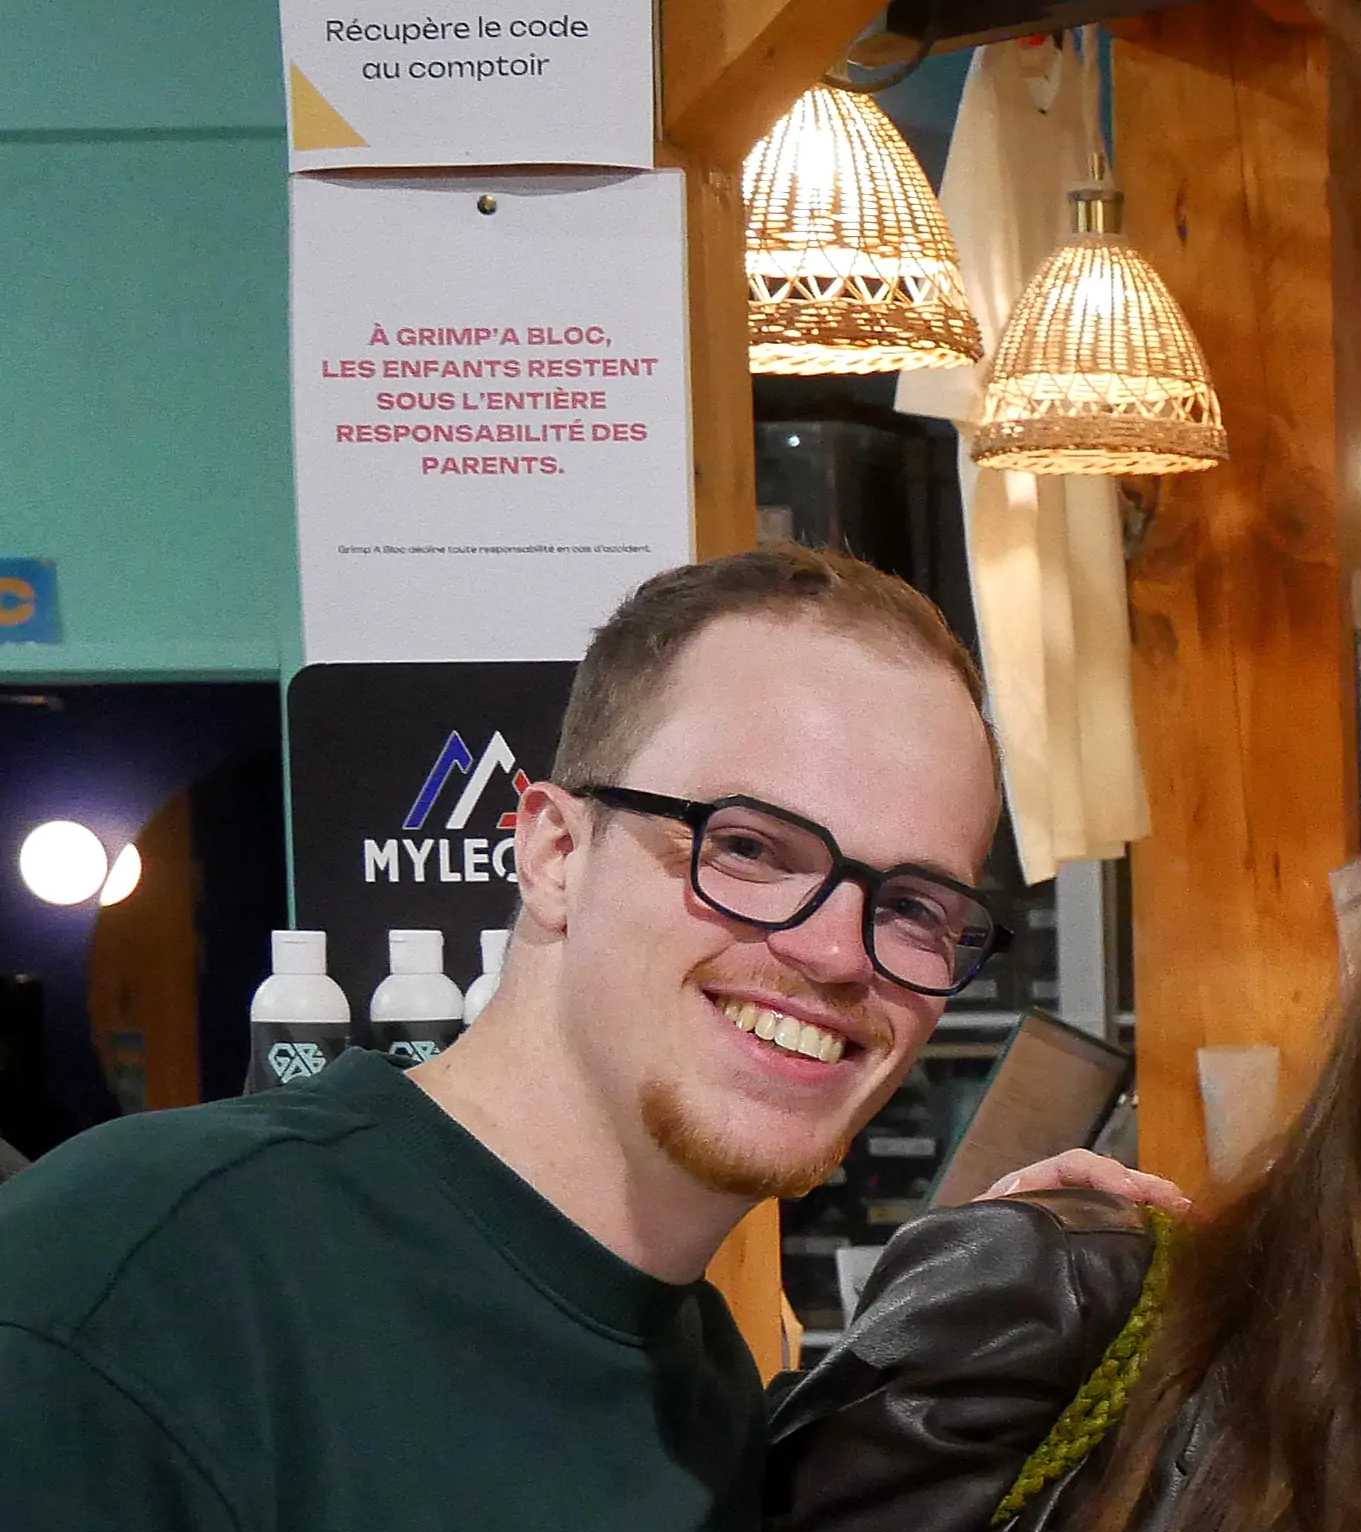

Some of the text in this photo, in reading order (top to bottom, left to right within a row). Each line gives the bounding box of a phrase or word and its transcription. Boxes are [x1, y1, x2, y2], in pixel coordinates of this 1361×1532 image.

[325, 15, 589, 44] Récupère le code
[362, 53, 550, 81] au comptoir
[367, 322, 390, 346] À
[527, 326, 612, 347] BLOC,
[322, 358, 659, 378] LES ENFANTS RESTENT
[377, 387, 607, 410] SOUS L'ENTIÈRE
[336, 419, 648, 442] RESPONSABILITÉ DES
[422, 456, 565, 474] PARENTS.
